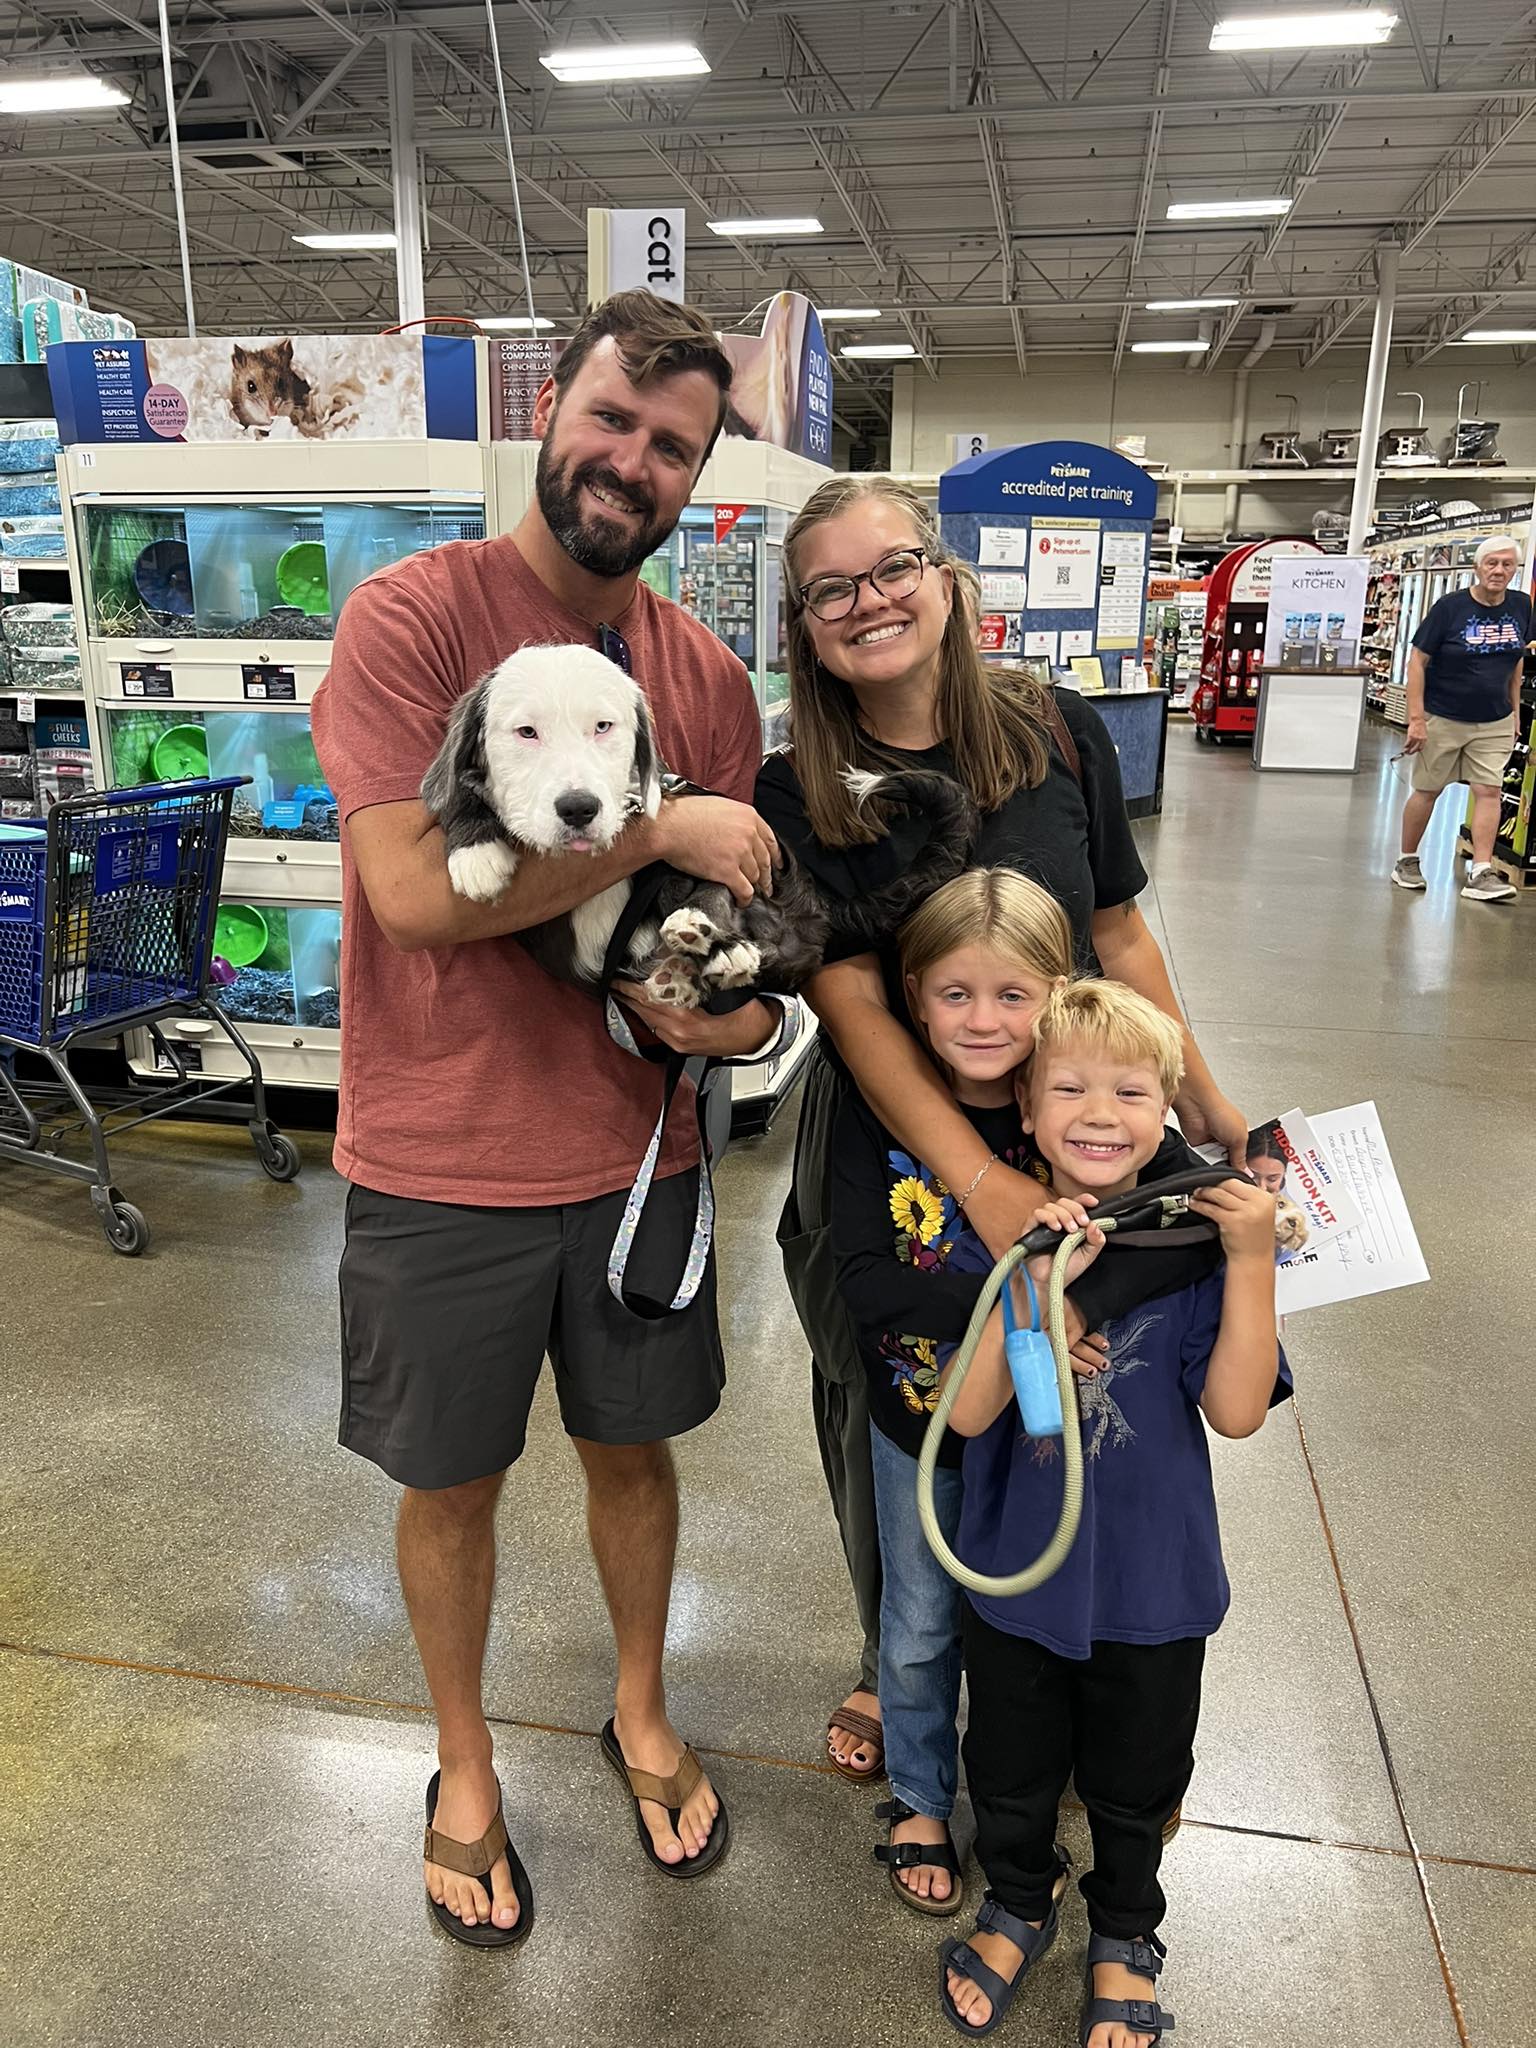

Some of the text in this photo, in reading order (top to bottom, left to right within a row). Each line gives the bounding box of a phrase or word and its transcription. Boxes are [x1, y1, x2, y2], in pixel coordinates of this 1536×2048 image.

[648, 216, 675, 283] cat
[501, 343, 543, 351] CHOOSING
[501, 352, 551, 360] COMPANION
[502, 363, 552, 371] CHINCHILLAS
[504, 388, 531, 396] FANCY
[149, 399, 180, 408] 14-DAY
[146, 409, 187, 417] Satisfaction
[504, 408, 532, 416] FANCY
[149, 418, 186, 426] Guarantee
[82, 454, 92, 466] 11
[1050, 463, 1091, 478] PETSMART
[1002, 480, 1133, 505] accredited pet training
[1053, 537, 1065, 546] Sign
[1152, 582, 1165, 590] Pet
[1292, 578, 1346, 589] KITCHEN
[1465, 623, 1519, 644] USA
[56, 723, 75, 733] FULL
[52, 733, 81, 743] CHEEKS
[65, 750, 92, 759] BEDDIN
[0, 890, 30, 907] SMART
[1308, 1150, 1332, 1184] PETSMART
[1272, 1128, 1321, 1199] ADOPTION
[1315, 1200, 1337, 1223] KIT
[1304, 1201, 1314, 1212] for
